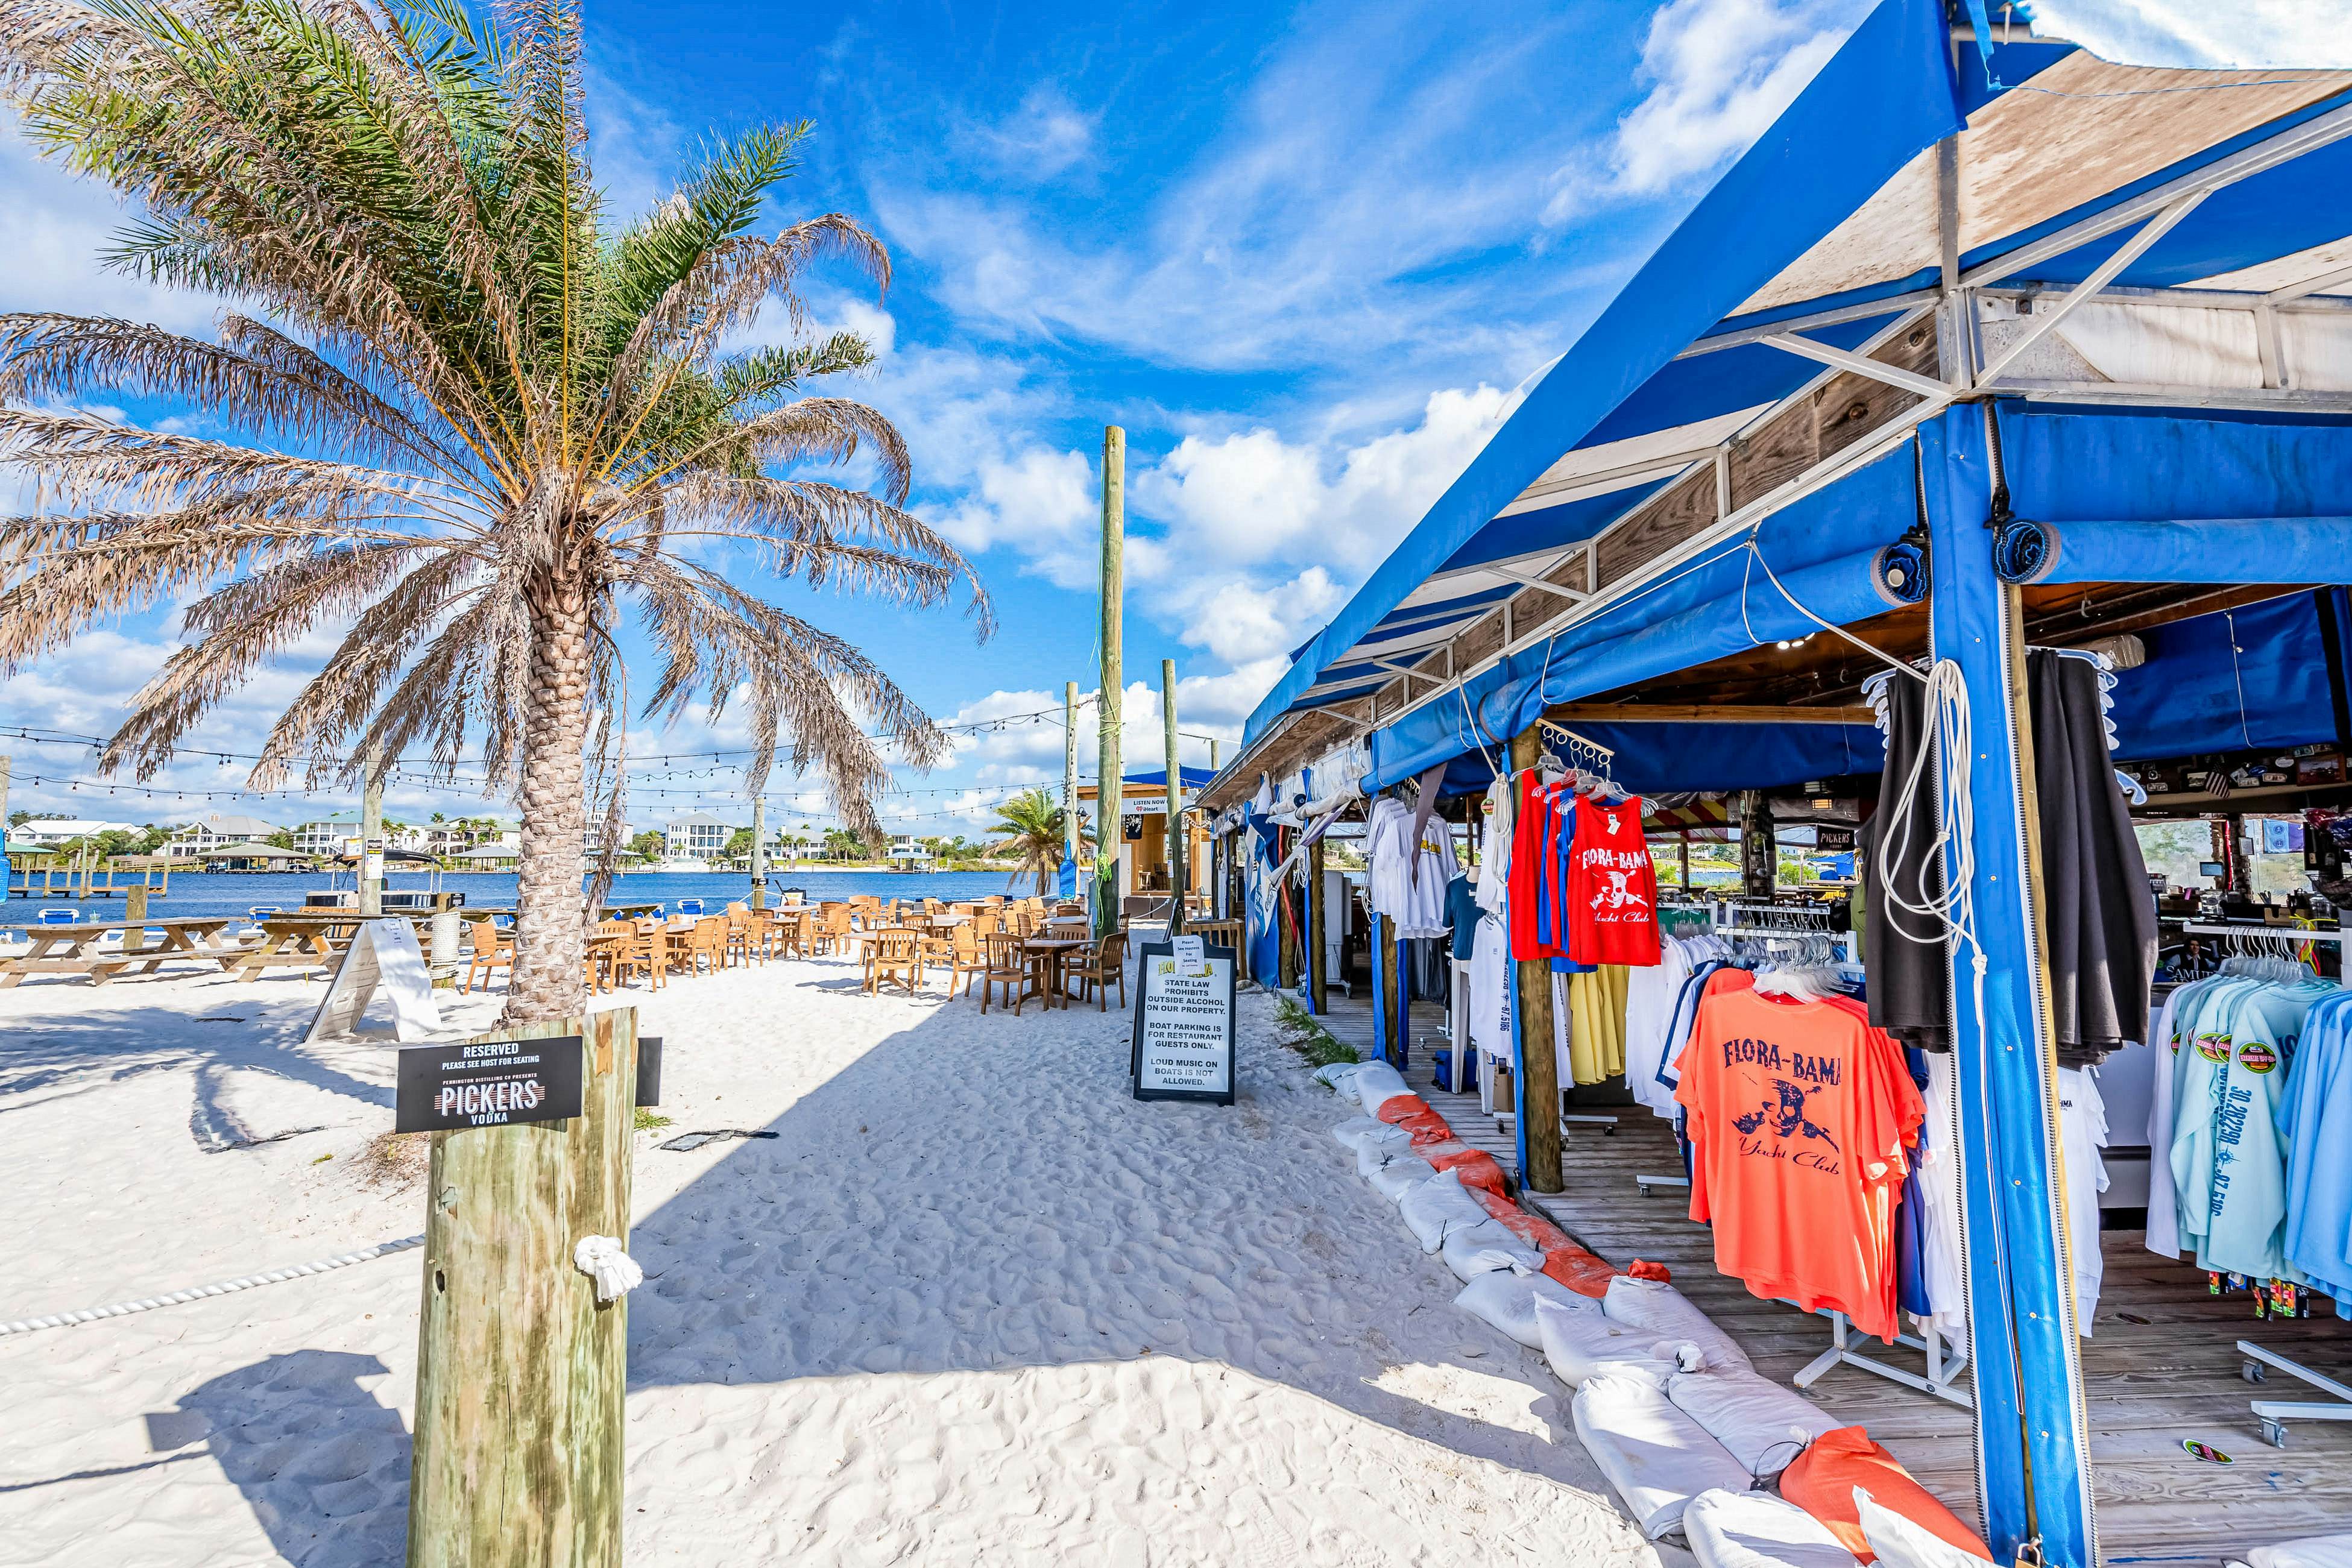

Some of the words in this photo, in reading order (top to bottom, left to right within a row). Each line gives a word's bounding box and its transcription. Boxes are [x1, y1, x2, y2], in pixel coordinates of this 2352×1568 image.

[1821, 833, 1850, 843] PICKERS
[1582, 848, 1648, 871] FLORA-BAMA
[1622, 912, 1649, 922] Club
[1165, 988, 1209, 997] PROHIBITS
[1501, 1005, 1510, 1031] -87.5186
[1167, 1032, 1222, 1041] RESTAURANT
[463, 1043, 519, 1058] RESERVED
[442, 1061, 466, 1071] PLEASE
[467, 1060, 479, 1068] SEE
[481, 1059, 498, 1067] HOST
[512, 1055, 540, 1065] SEATING
[1162, 1077, 1205, 1086] ALLOWED.
[441, 1080, 540, 1116] PICKERS
[471, 1112, 508, 1125] VODKA
[2219, 1086, 2252, 1145] 30.282298
[1738, 1136, 1786, 1159] Yacht
[1792, 1151, 1840, 1175] Club
